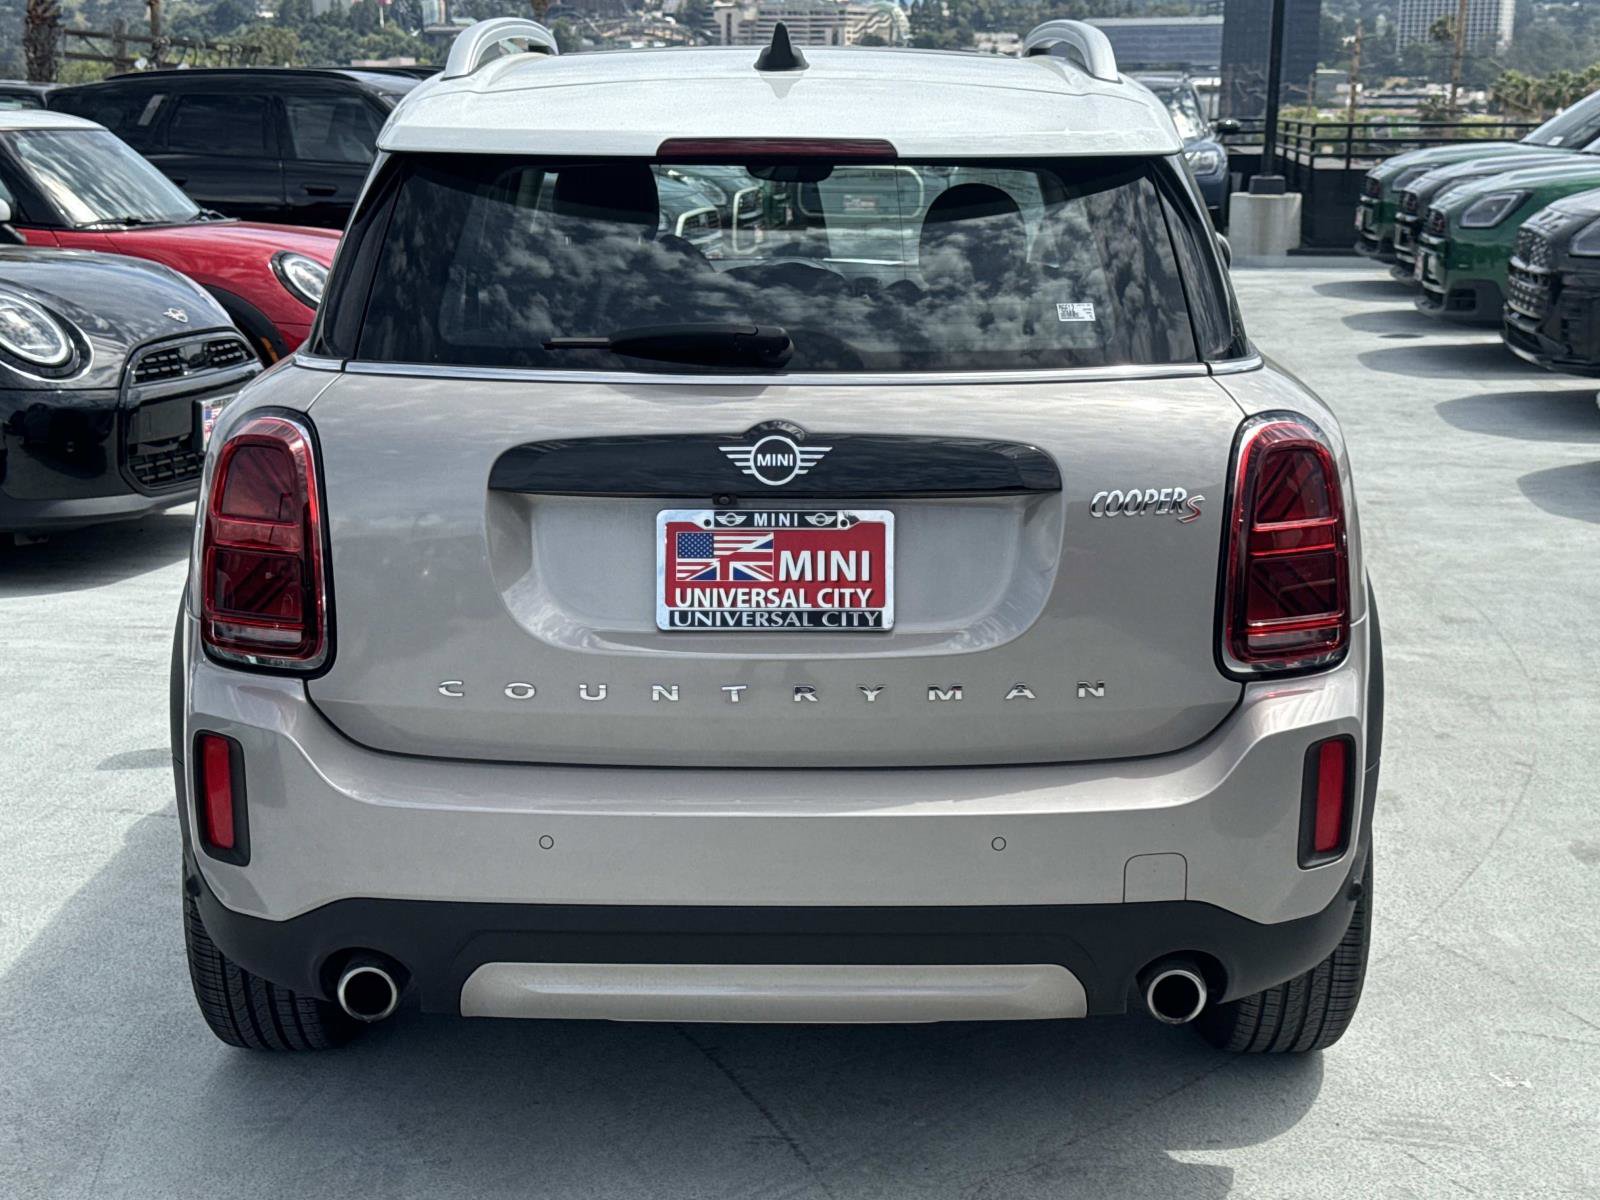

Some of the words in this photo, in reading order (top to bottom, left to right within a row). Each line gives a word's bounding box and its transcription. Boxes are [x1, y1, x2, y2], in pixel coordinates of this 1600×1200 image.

[757, 453, 794, 467] MINI
[753, 512, 799, 527] MINI
[778, 550, 870, 582] MINI
[675, 588, 812, 608] UNIVERSAL
[817, 588, 873, 608] CITY
[673, 611, 814, 627] UNIVERSAL
[821, 611, 879, 627] CITY
[438, 679, 1106, 702] COUNTRYMAN
